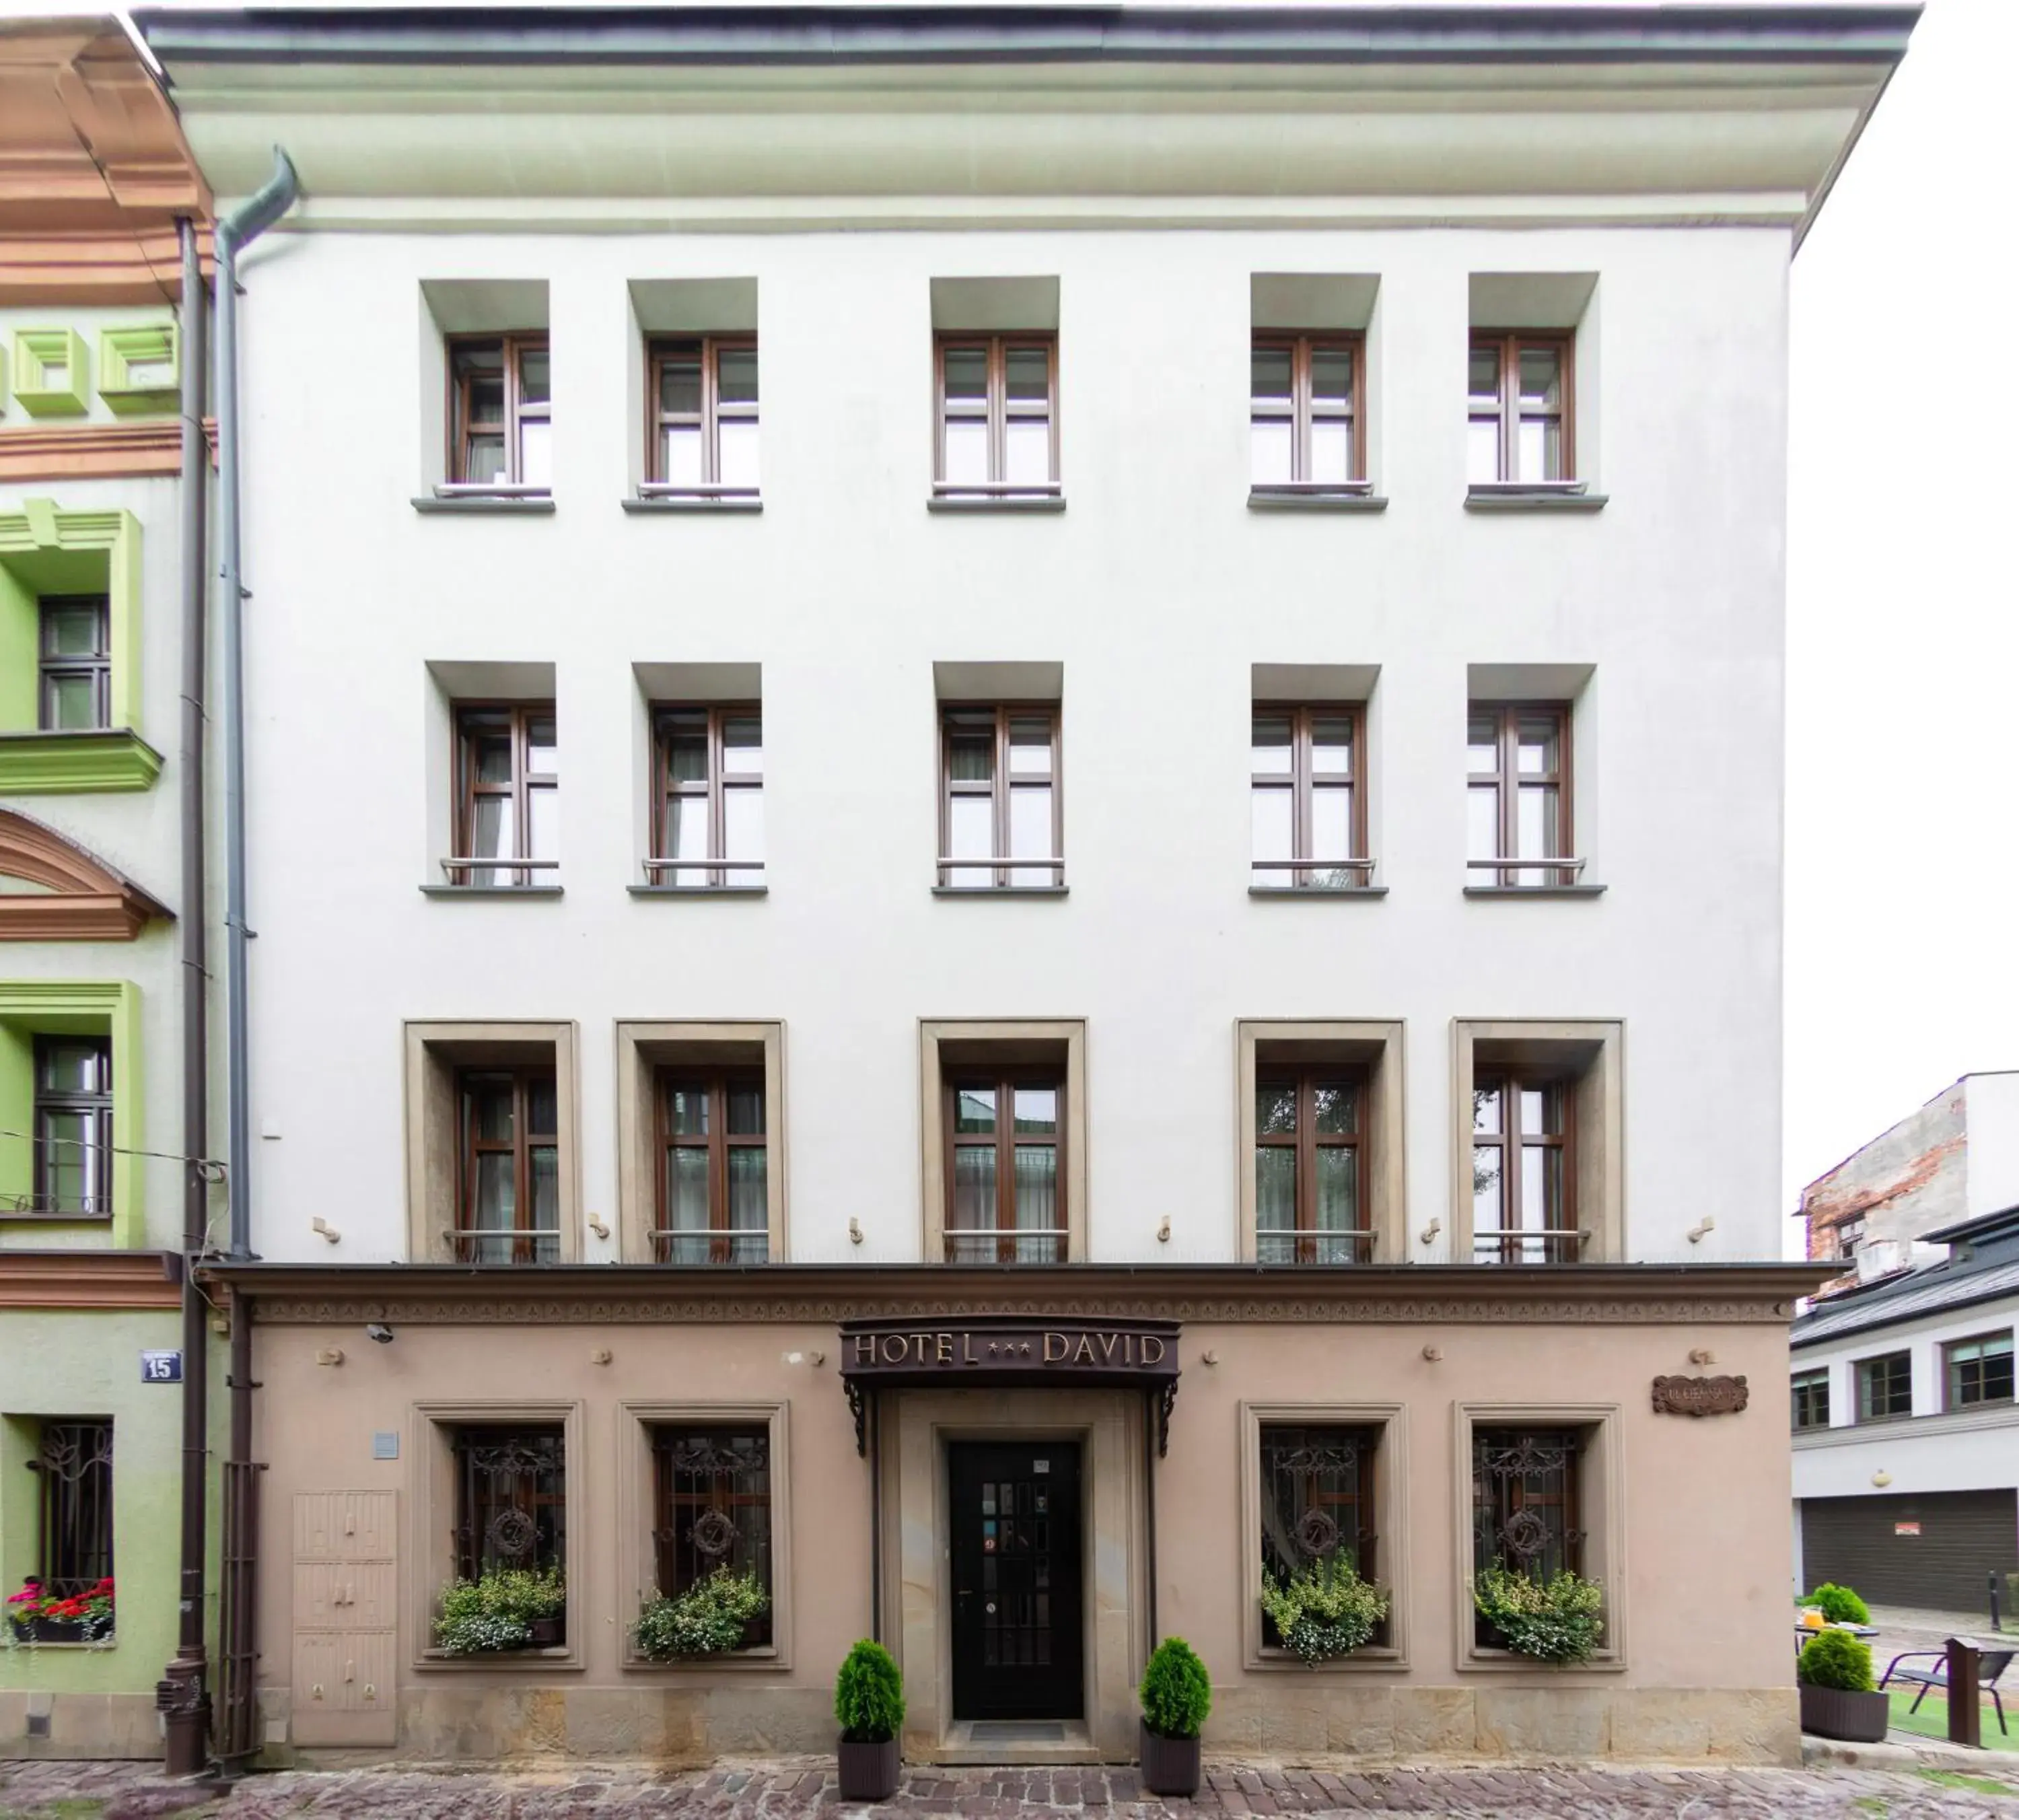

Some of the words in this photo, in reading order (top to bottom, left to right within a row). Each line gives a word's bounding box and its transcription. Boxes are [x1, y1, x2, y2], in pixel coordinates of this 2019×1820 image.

[855, 1333, 979, 1365] HOTEL
[1042, 1333, 1166, 1366] DAVID
[149, 1359, 171, 1378] 15
